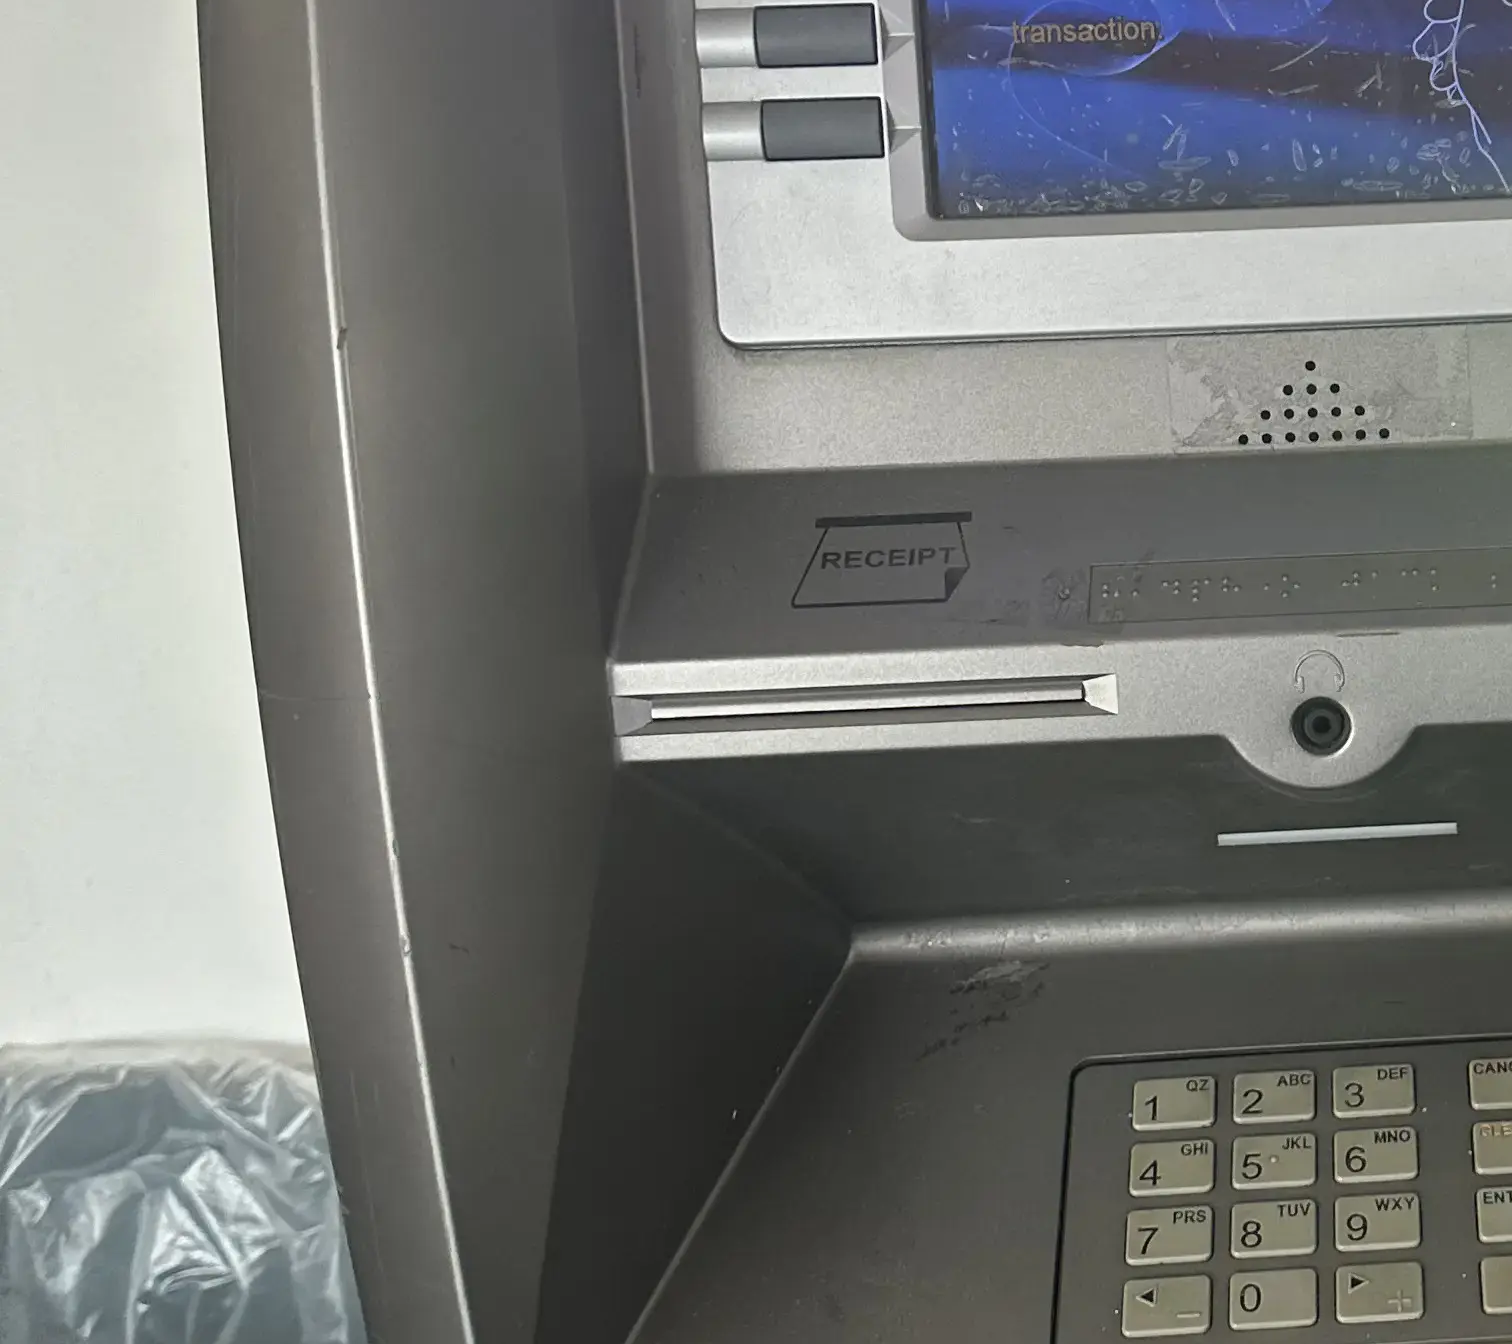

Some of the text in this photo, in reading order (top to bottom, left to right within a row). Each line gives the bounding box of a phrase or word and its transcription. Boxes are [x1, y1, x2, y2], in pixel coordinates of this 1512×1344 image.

[1012, 16, 1165, 44] transaction.
[821, 546, 957, 570] RECEIPT
[1186, 1079, 1209, 1092] QZ
[1277, 1073, 1312, 1087] ABC
[1377, 1067, 1409, 1081] DEF
[1144, 1095, 1158, 1121] 1
[1241, 1088, 1264, 1114] 2
[1344, 1082, 1365, 1108] 3
[1282, 1136, 1312, 1150] JKL
[1373, 1129, 1411, 1143] MNO
[1180, 1143, 1208, 1156] GHI
[1344, 1146, 1367, 1173] 6
[1139, 1159, 1161, 1187] 4
[1241, 1152, 1263, 1180] 5
[1172, 1209, 1207, 1224] PRS
[1276, 1202, 1312, 1217] TUV
[1374, 1196, 1415, 1211] WXY
[1240, 1220, 1263, 1248] 8
[1346, 1213, 1368, 1241] 9
[1137, 1226, 1159, 1256] 7
[1239, 1283, 1262, 1313] 0
